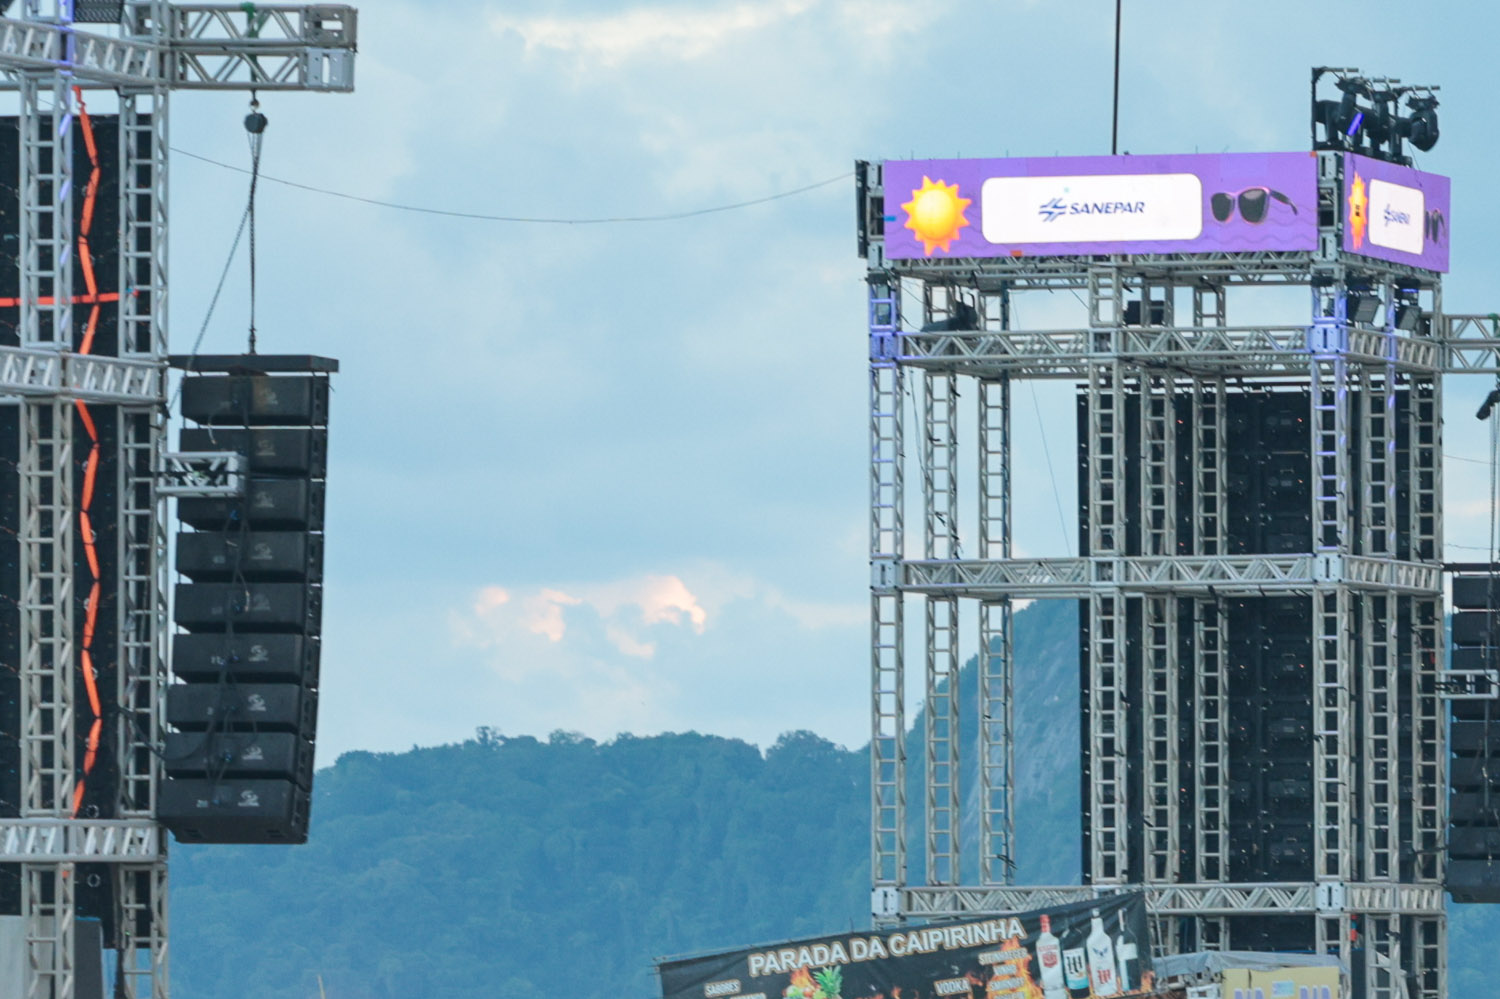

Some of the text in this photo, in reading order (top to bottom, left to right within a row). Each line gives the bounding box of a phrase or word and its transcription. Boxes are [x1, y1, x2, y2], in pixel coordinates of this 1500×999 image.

[1070, 202, 1145, 214] SANEPAR
[750, 918, 1025, 975] PARADA DA CAIPIRINHA
[936, 979, 970, 994] VODKA
